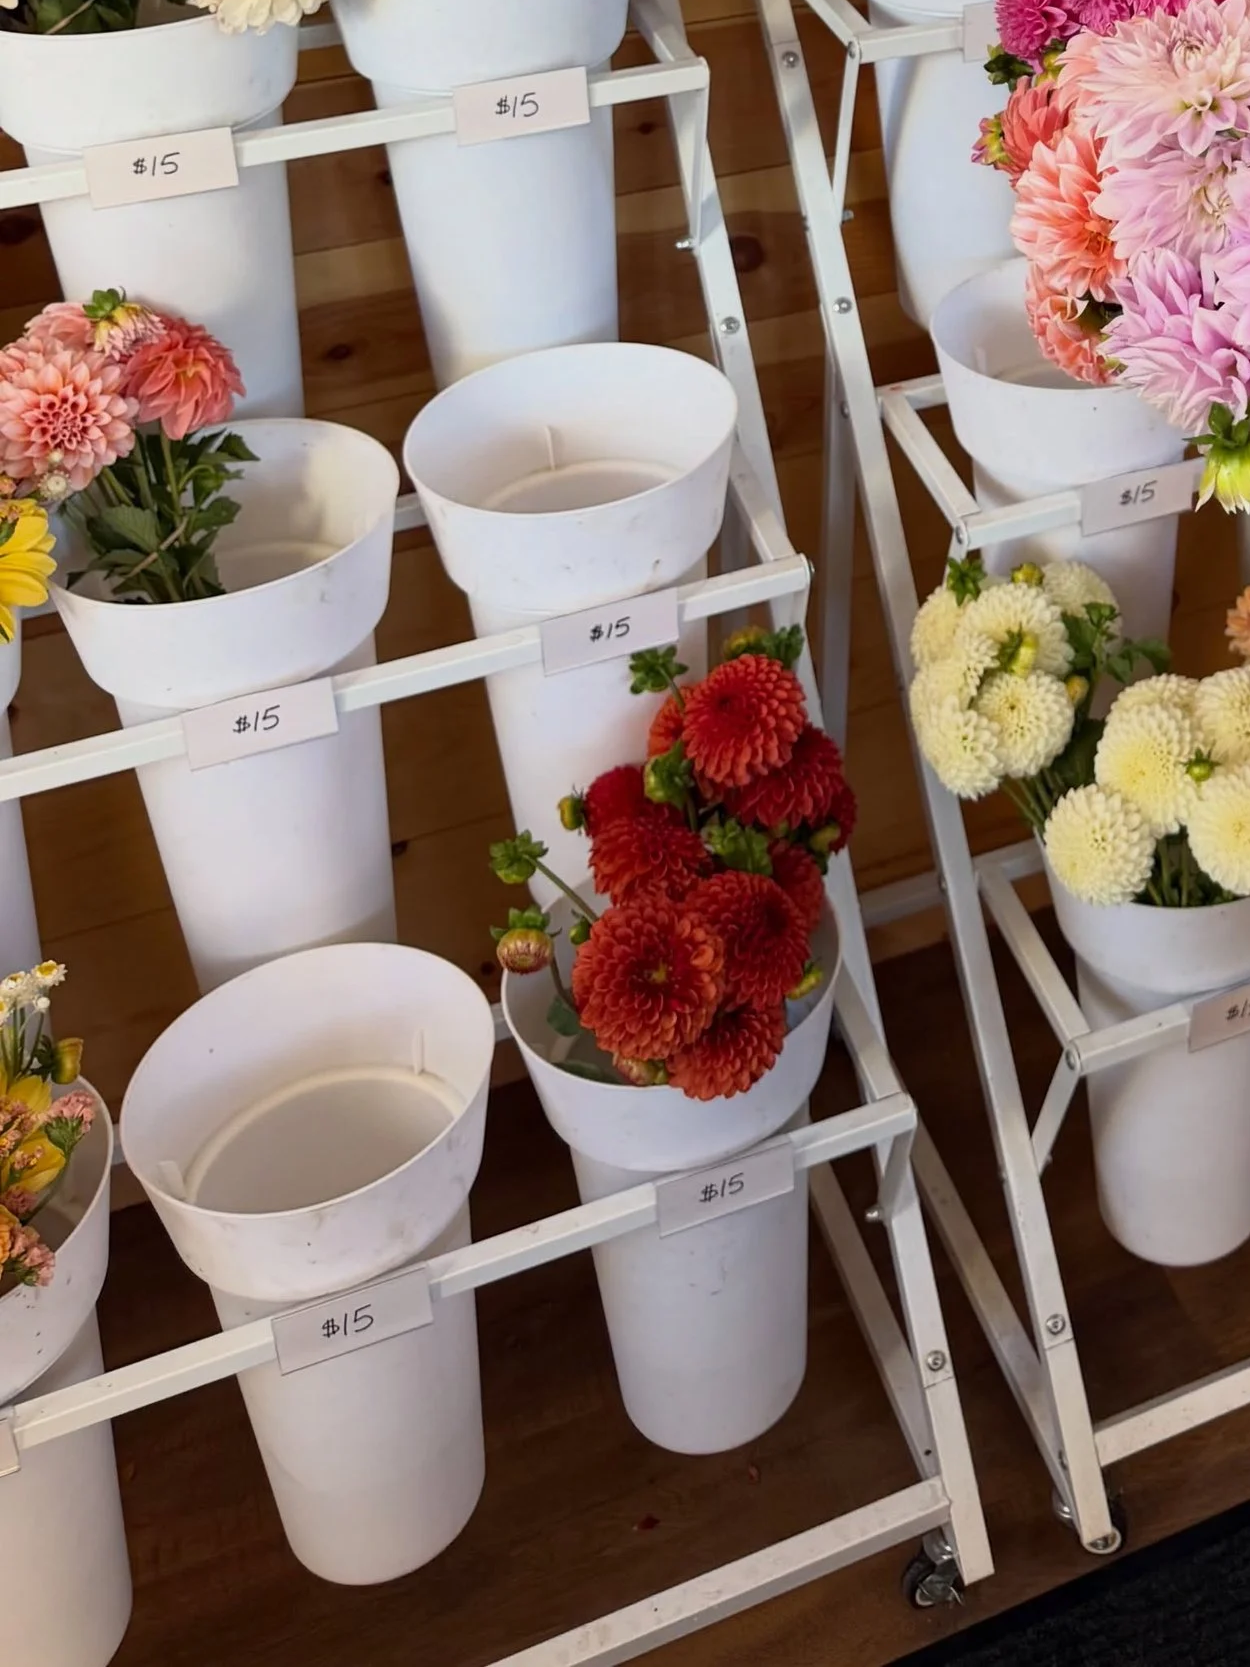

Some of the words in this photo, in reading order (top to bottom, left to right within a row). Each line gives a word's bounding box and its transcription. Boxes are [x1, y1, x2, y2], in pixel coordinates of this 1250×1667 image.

[495, 91, 540, 118] $15
[132, 151, 181, 177] $15
[1119, 479, 1158, 506] $15
[589, 615, 632, 643] $15
[232, 704, 282, 734] $15
[699, 1172, 746, 1203] $15
[321, 1303, 376, 1339] $15
